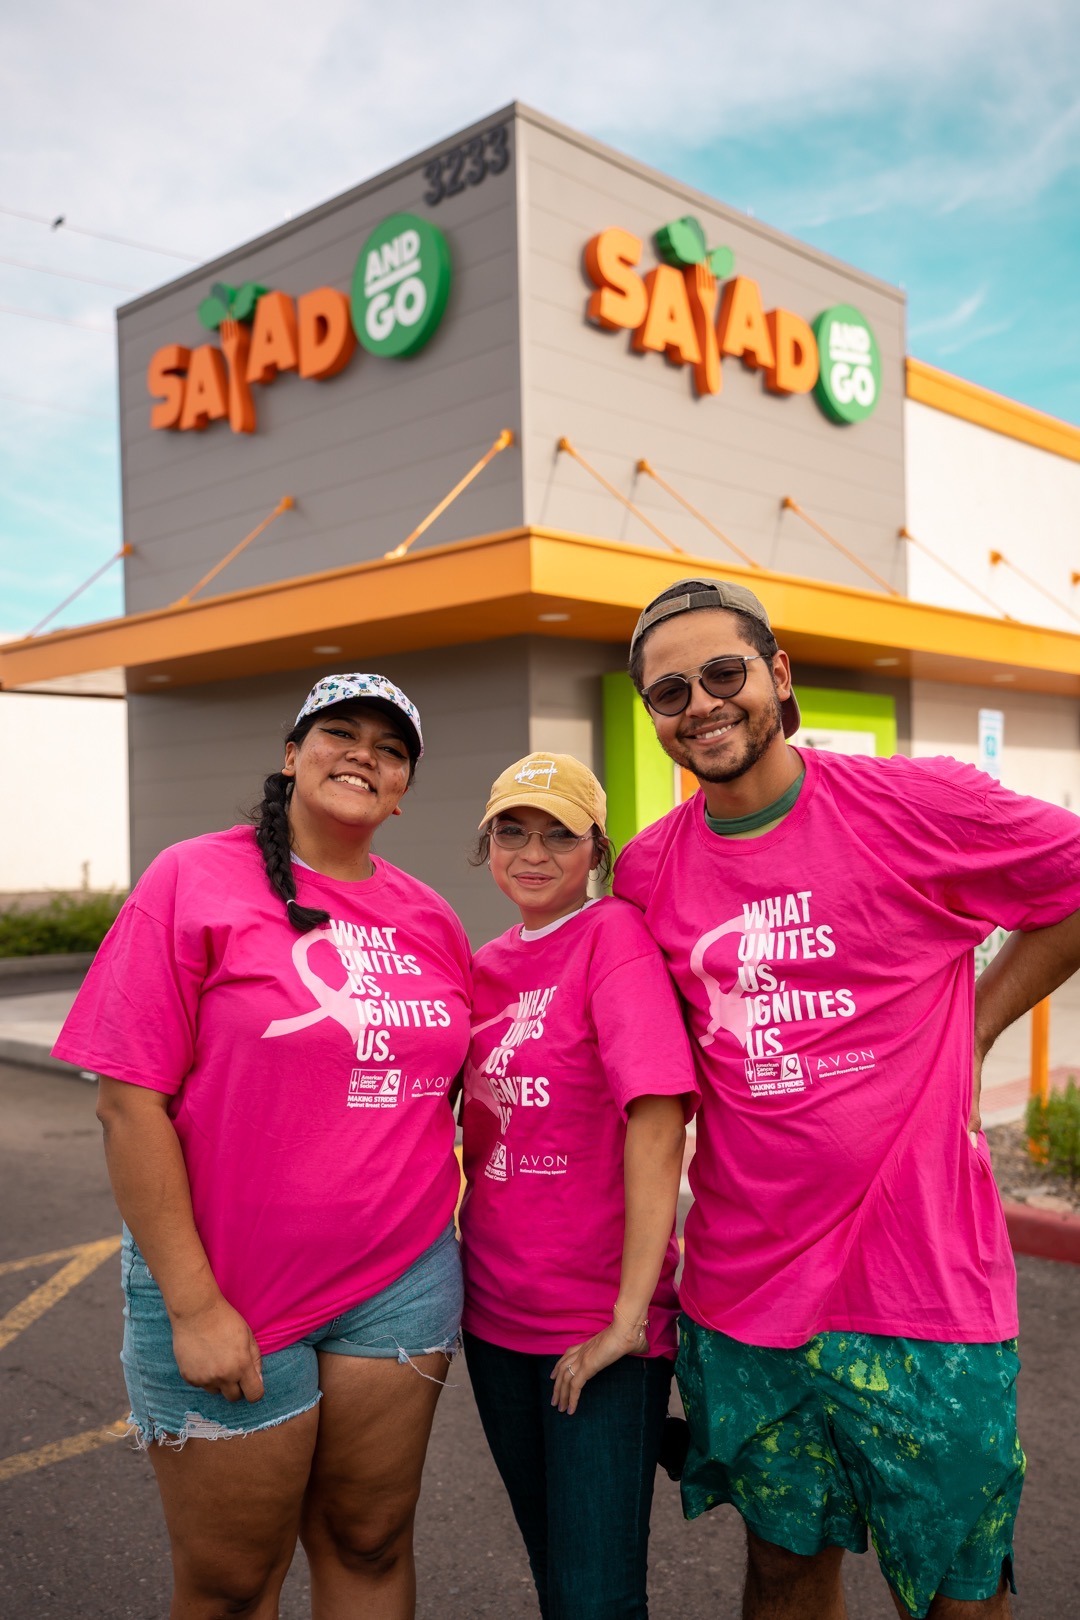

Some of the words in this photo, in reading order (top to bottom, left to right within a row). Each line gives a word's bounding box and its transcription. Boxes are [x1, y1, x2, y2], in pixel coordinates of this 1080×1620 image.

[423, 126, 510, 207] 3233
[365, 230, 421, 283] AND
[365, 277, 427, 342] GO
[829, 321, 872, 353] AND
[830, 362, 875, 407] GO
[742, 891, 812, 931] WHAT
[329, 919, 397, 951] WHAT
[737, 924, 836, 962] UNITES
[336, 949, 422, 976] UNITES
[737, 963, 786, 993] US,
[346, 971, 390, 999] US,
[351, 999, 451, 1027] IGNITES
[745, 988, 856, 1027] IGNITES
[356, 1029, 396, 1062] US.
[817, 1049, 875, 1070] AVON
[347, 1095, 373, 1103] MAKING
[777, 1080, 804, 1089] STRIDES
[520, 1154, 568, 1167] AVON
